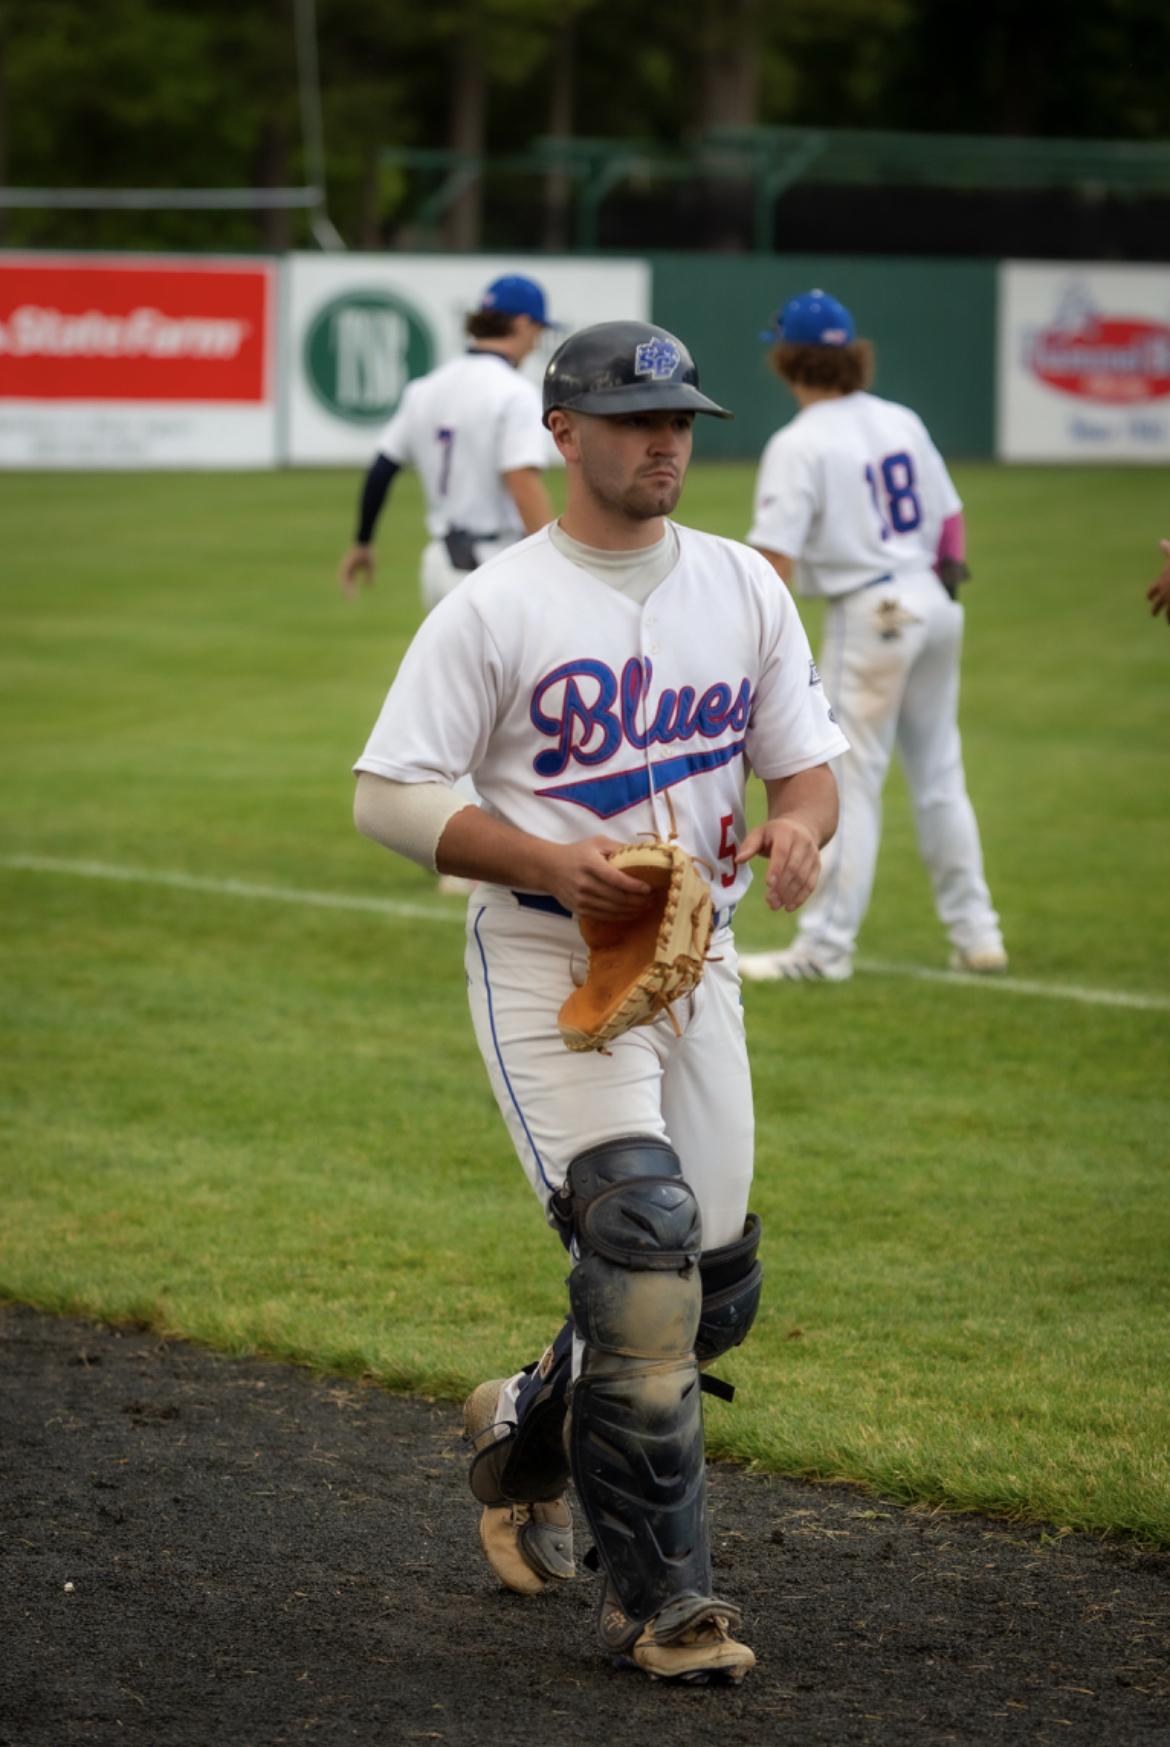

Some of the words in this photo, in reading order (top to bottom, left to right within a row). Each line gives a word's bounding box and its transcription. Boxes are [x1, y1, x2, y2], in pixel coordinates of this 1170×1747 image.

[435, 426, 456, 496] 7
[864, 452, 922, 540] 18
[530, 656, 755, 777] Blues
[718, 814, 738, 888] 5
